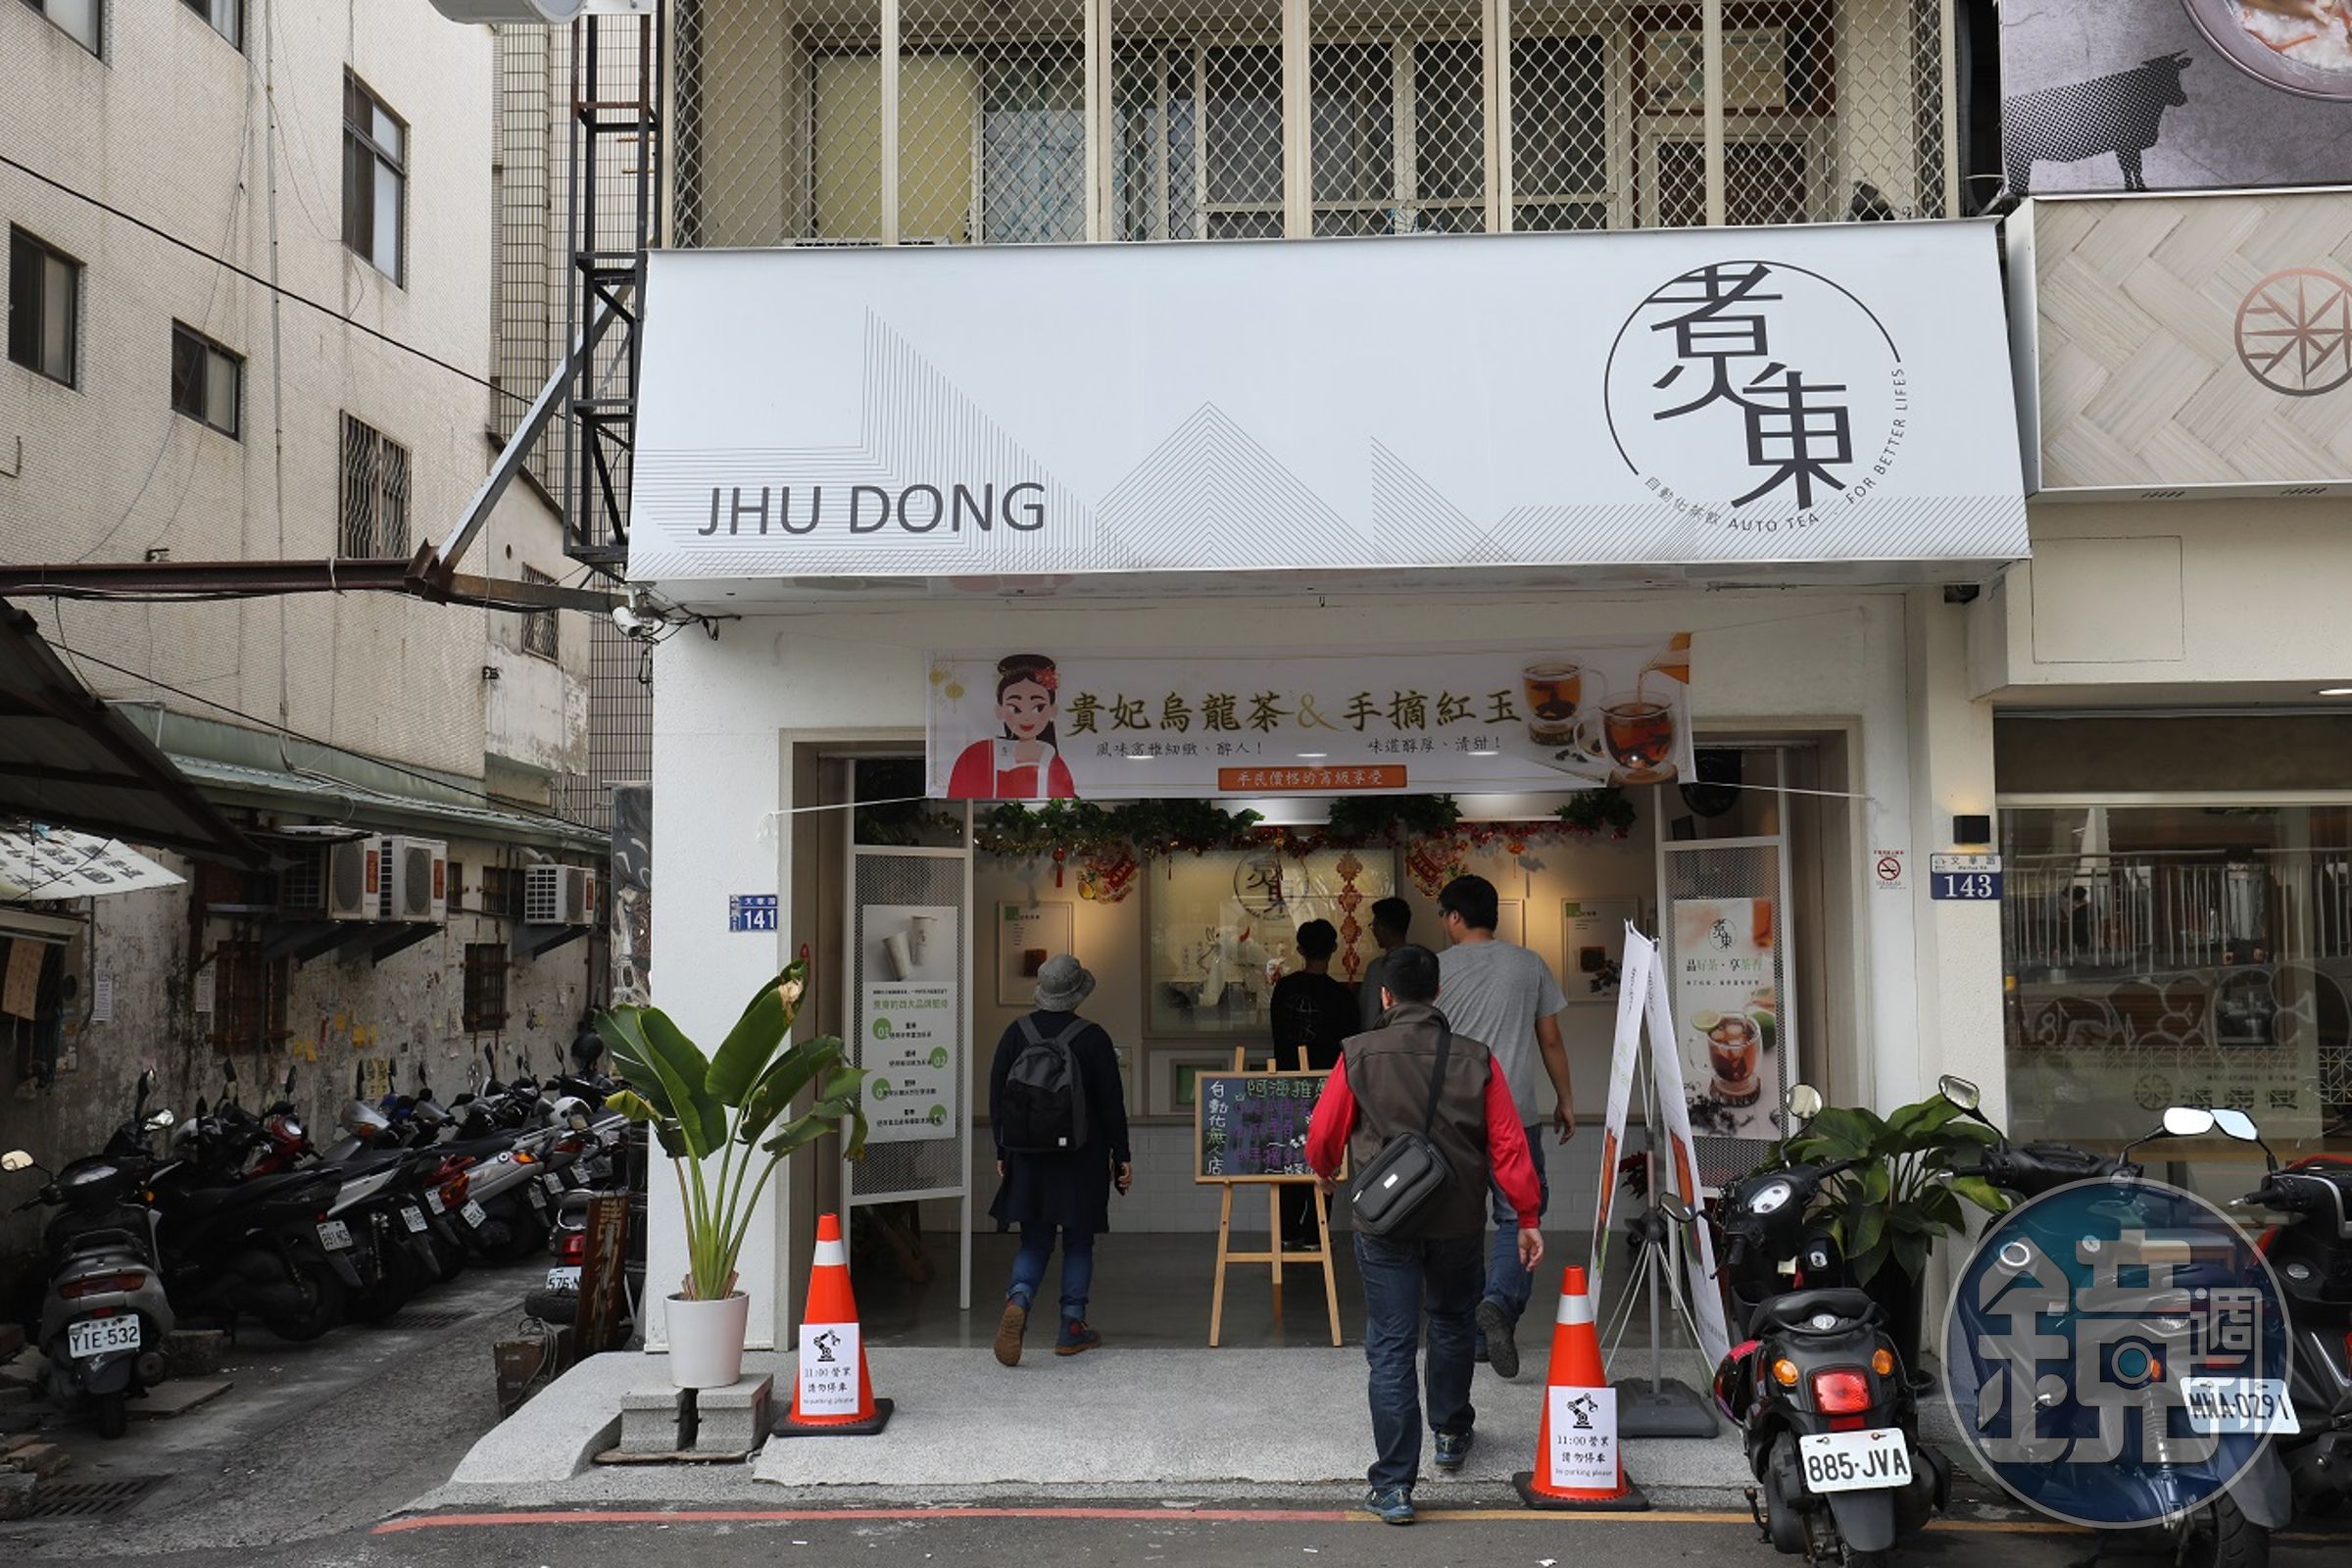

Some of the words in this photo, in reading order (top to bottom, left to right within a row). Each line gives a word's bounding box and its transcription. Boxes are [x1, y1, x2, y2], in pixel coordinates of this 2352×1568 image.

[1728, 517, 1778, 533] AUTO
[1786, 512, 1820, 530] TEA
[1845, 476, 1877, 505] FOR
[1873, 418, 1907, 476] BETTER
[1890, 368, 1909, 412] LIFES
[698, 486, 822, 536] JHU
[849, 482, 1047, 533] DONG
[1943, 874, 1993, 899] 143
[745, 909, 775, 930] 141
[1206, 1080, 1228, 1175] 自動化無人店
[72, 1326, 139, 1351] YIE-532
[1557, 1435, 1587, 1446] 11:00
[1562, 1451, 1606, 1463] 請勿停車
